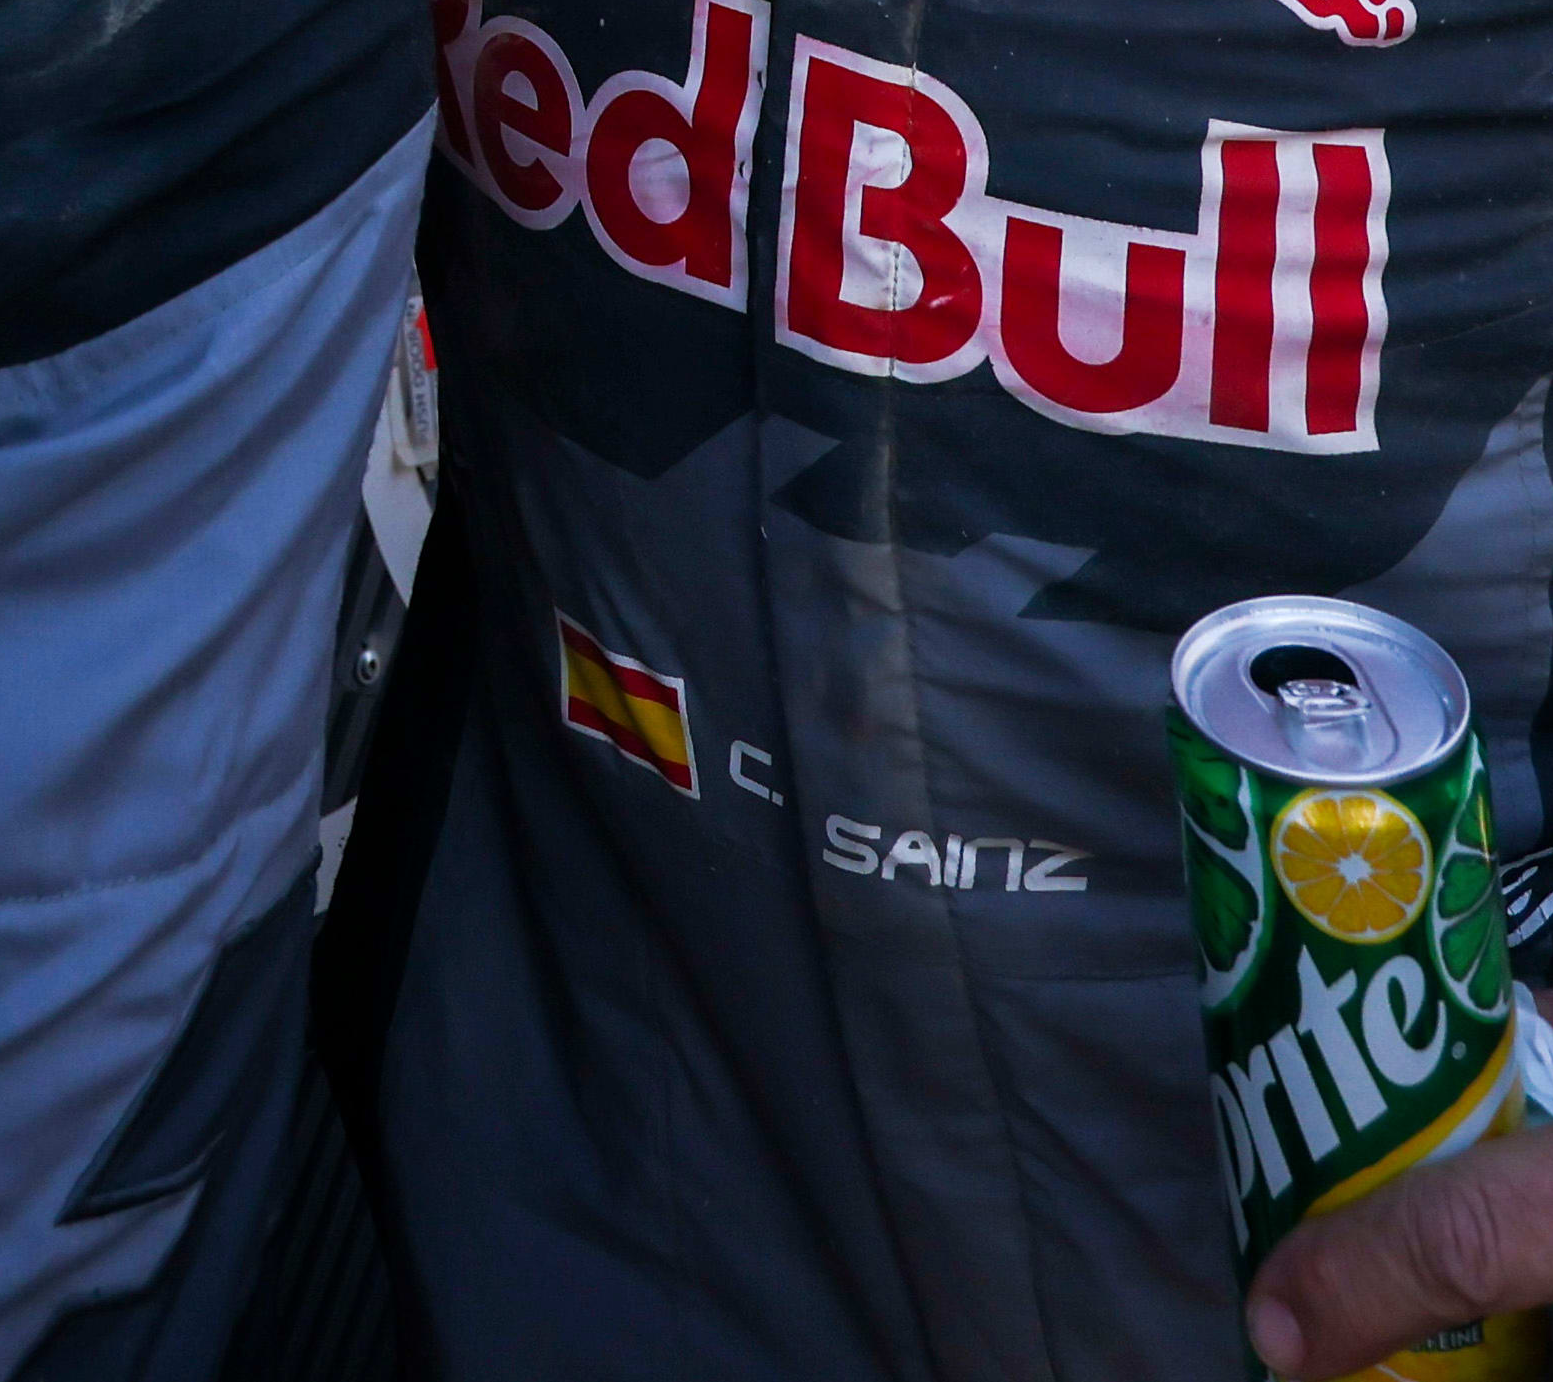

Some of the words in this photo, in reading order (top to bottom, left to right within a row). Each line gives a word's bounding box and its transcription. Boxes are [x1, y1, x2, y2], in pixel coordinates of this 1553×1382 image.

[777, 36, 1384, 450] Bull
[729, 740, 783, 806] C.
[823, 815, 1093, 891] SAINZ
[1211, 943, 1448, 1255] prite
